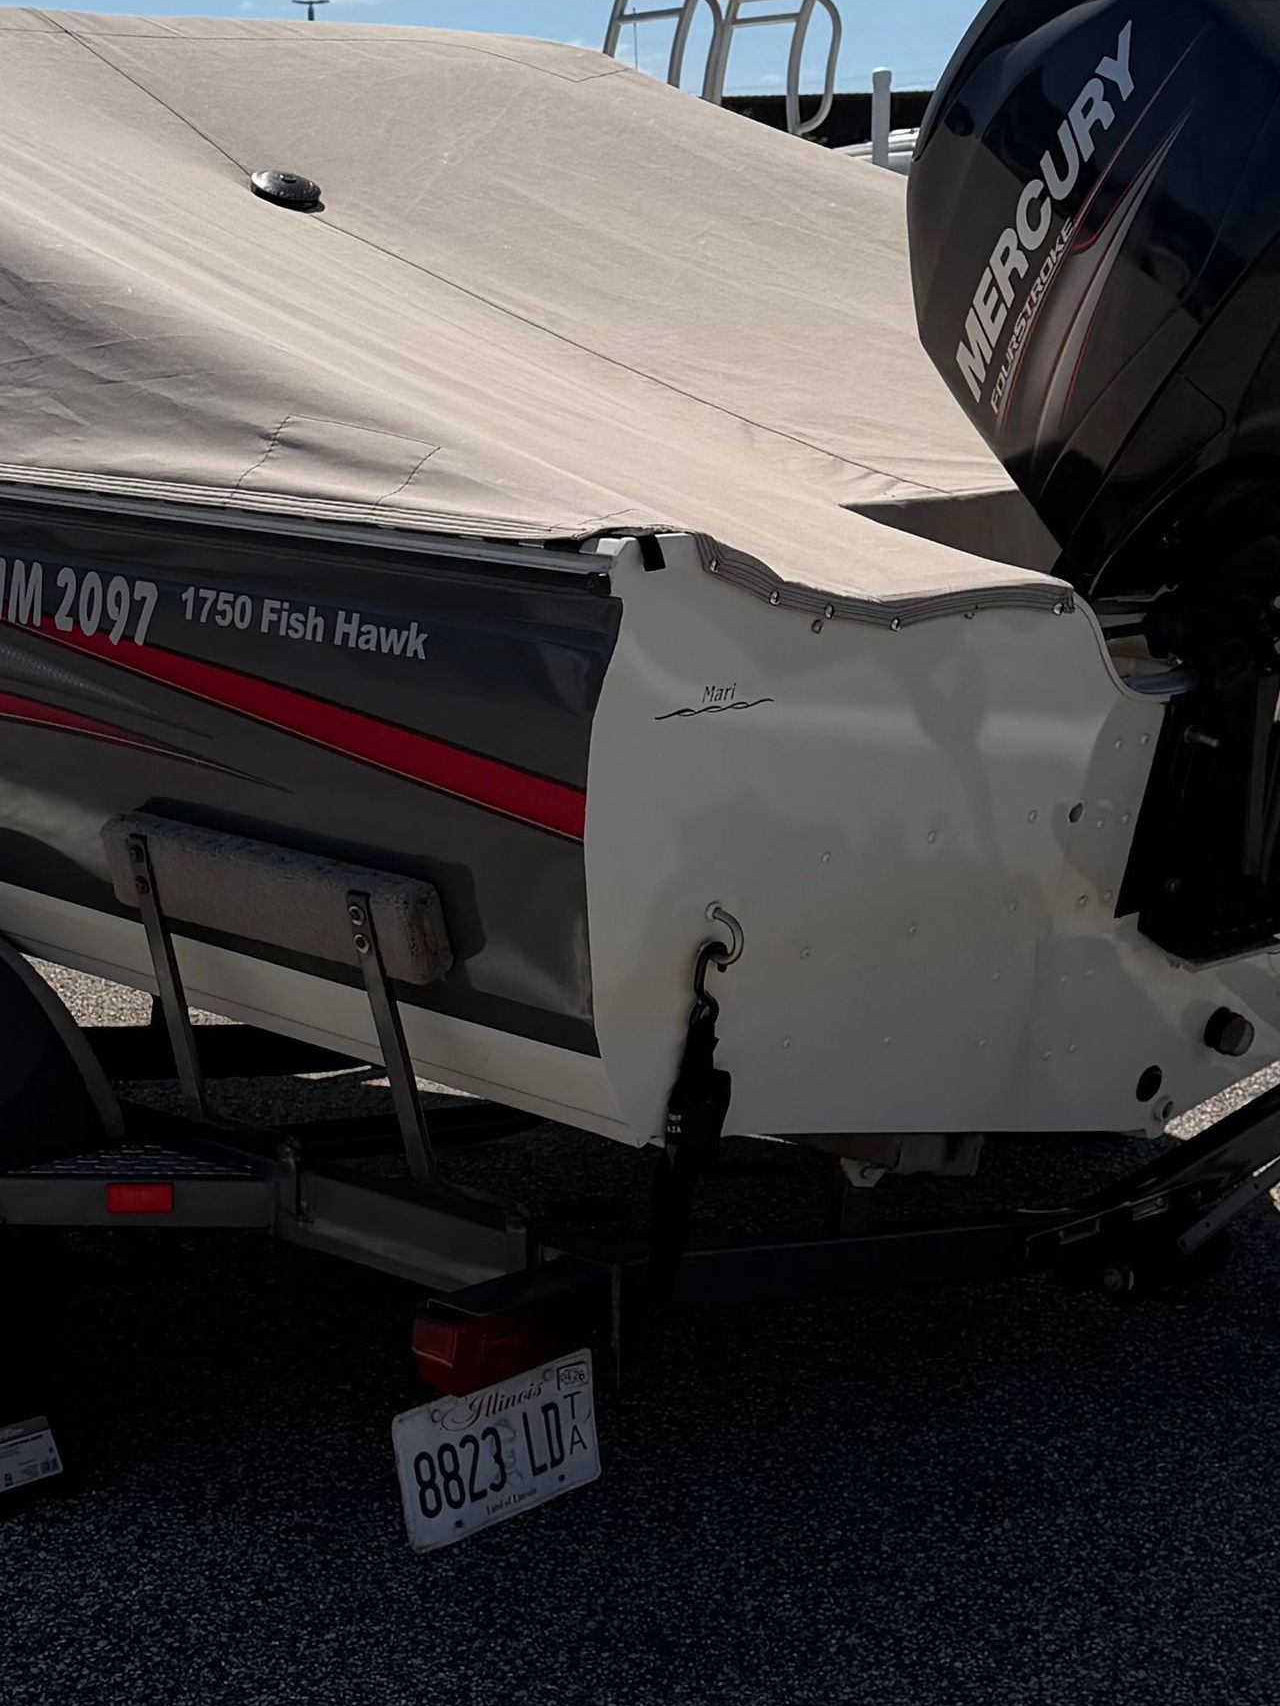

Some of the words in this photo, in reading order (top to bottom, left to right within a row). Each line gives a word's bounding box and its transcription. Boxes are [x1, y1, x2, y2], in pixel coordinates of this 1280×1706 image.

[955, 19, 1136, 403] MERCURY
[989, 217, 1074, 415] FOURSTROKE
[54, 566, 159, 646] 2097
[181, 585, 253, 631] 1750
[259, 599, 325, 643] Fish
[333, 609, 429, 661] Hawk
[701, 682, 737, 703] Mari
[441, 1382, 544, 1432] Illinois
[413, 1426, 507, 1518] 8823
[522, 1401, 566, 1477] LD
